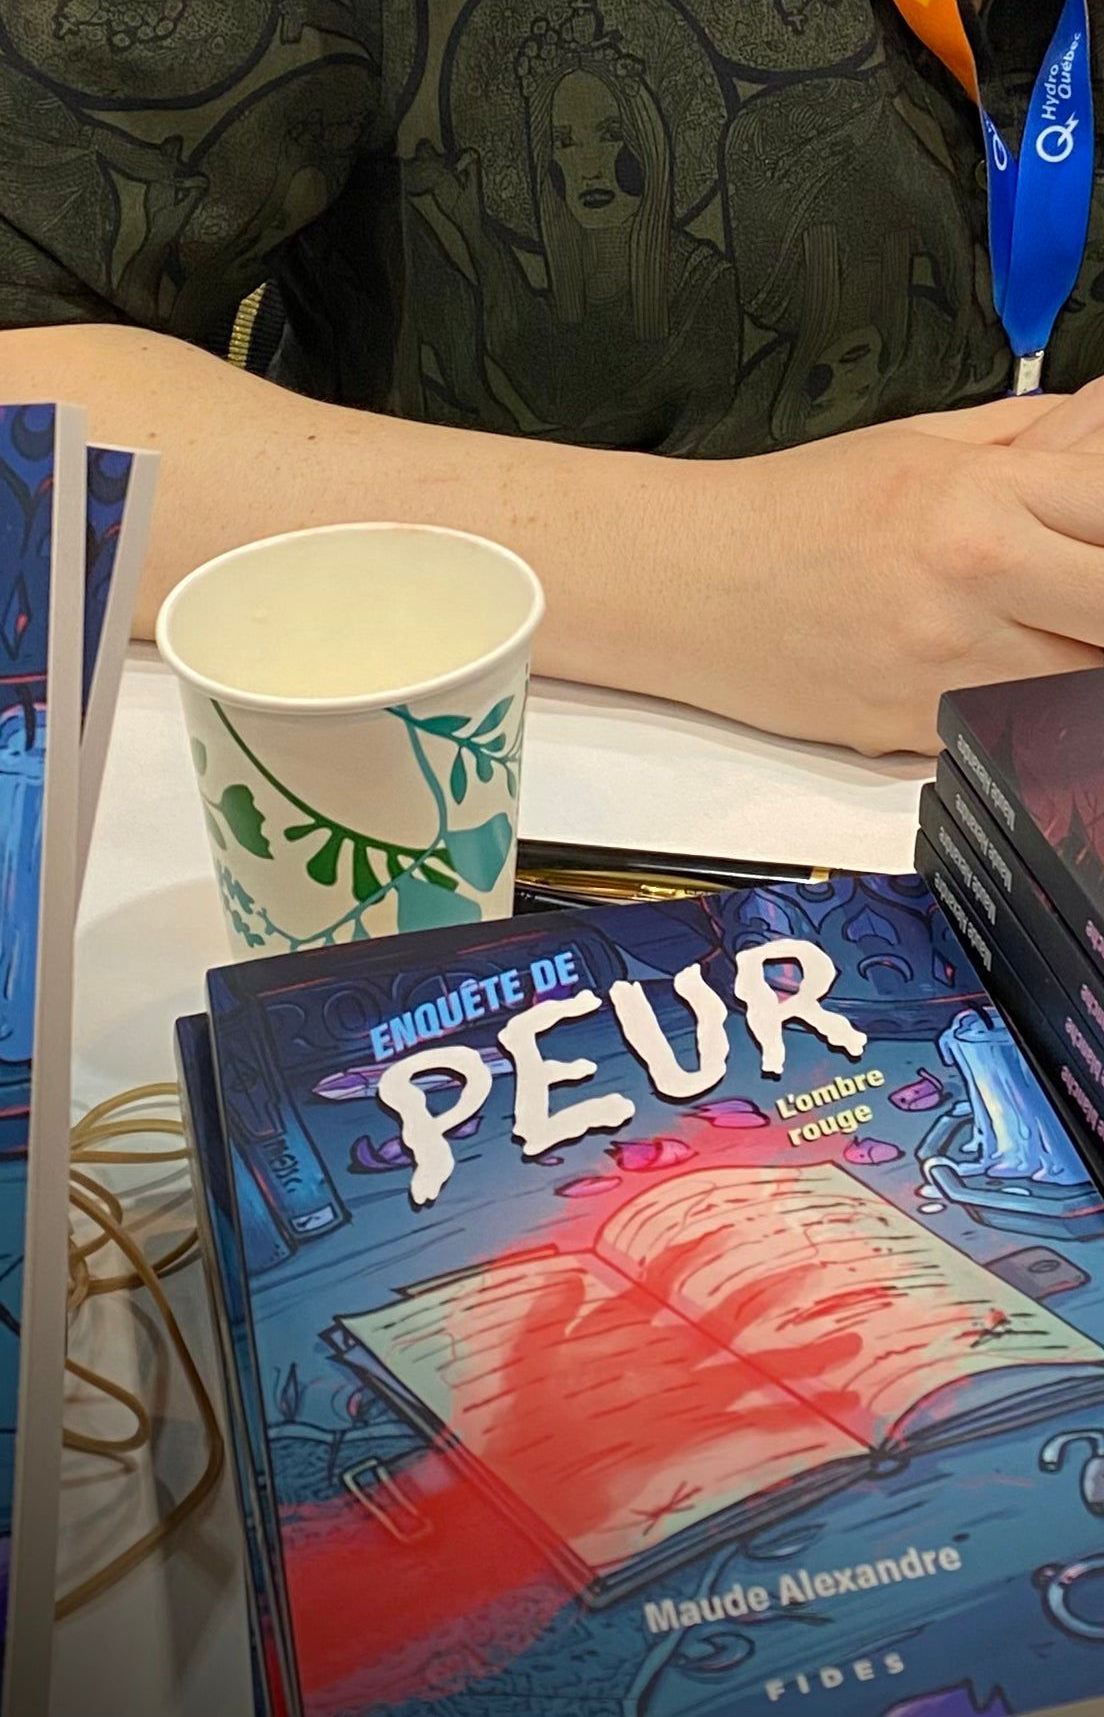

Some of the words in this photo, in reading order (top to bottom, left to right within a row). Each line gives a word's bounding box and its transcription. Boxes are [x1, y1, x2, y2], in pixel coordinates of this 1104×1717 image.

[1041, 64, 1059, 120] Hydro
[1058, 33, 1081, 100] Québec
[369, 967, 523, 1062] ENQUÊTE
[530, 950, 580, 994] DE
[377, 937, 868, 1205] PEUR
[774, 1066, 886, 1120] L'ombre
[787, 1102, 874, 1147] rouge
[644, 1583, 771, 1634] Maude
[779, 1545, 963, 1606] Alexandre
[764, 1651, 906, 1702] FIDES
